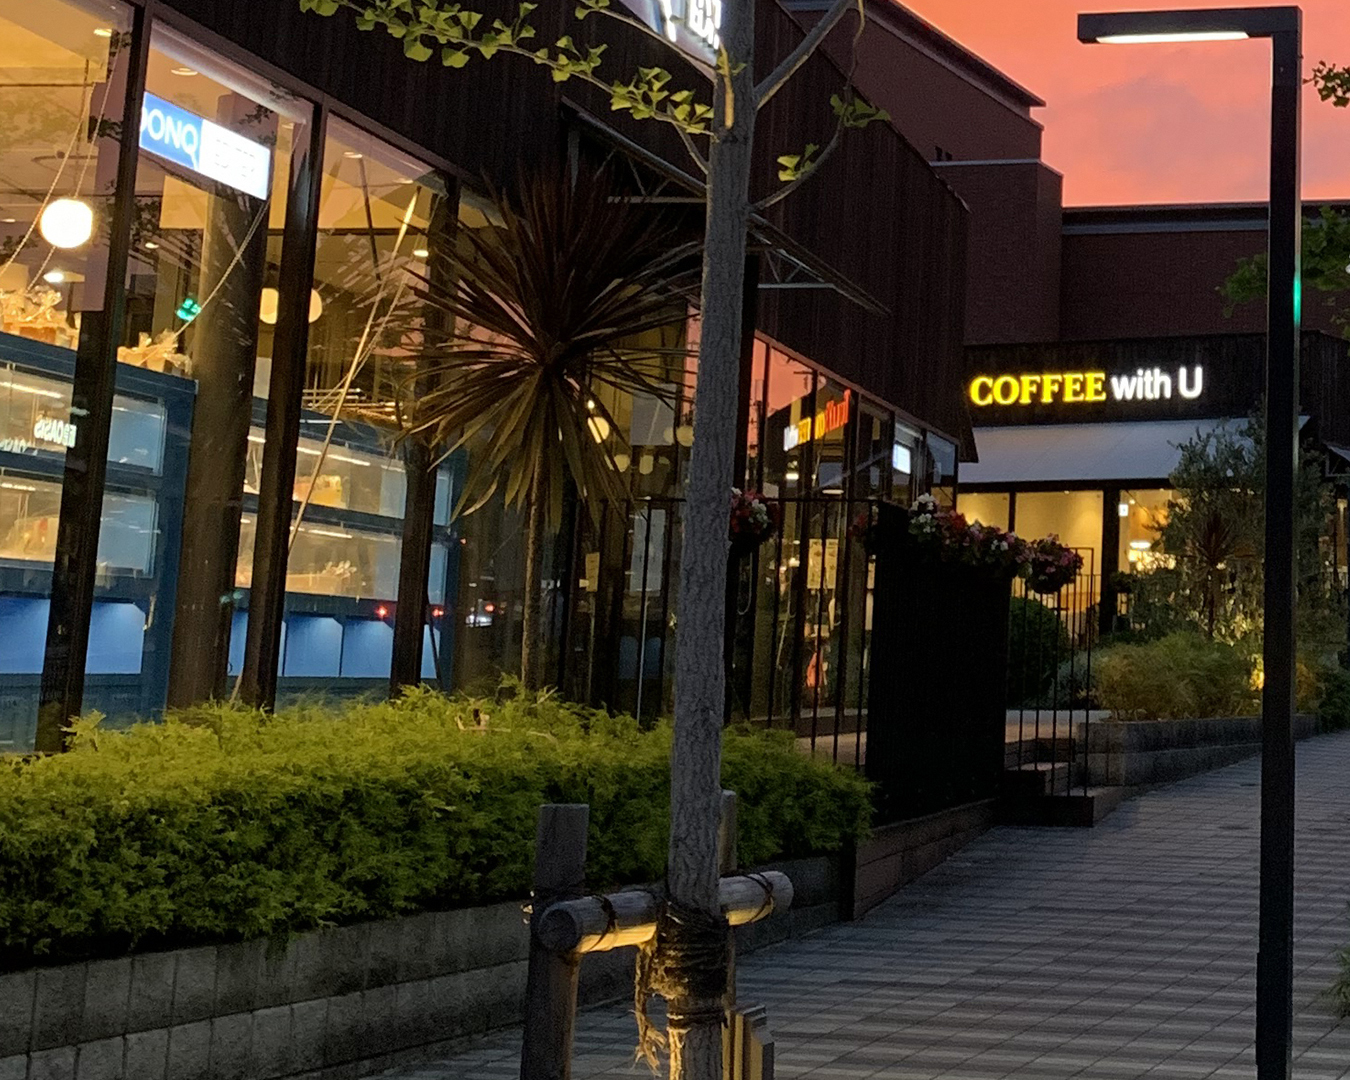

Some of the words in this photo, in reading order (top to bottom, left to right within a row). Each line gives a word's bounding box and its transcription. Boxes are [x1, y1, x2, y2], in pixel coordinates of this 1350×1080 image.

[969, 372, 1107, 406] COFFEE
[1110, 367, 1172, 401] with
[1179, 364, 1203, 399] U
